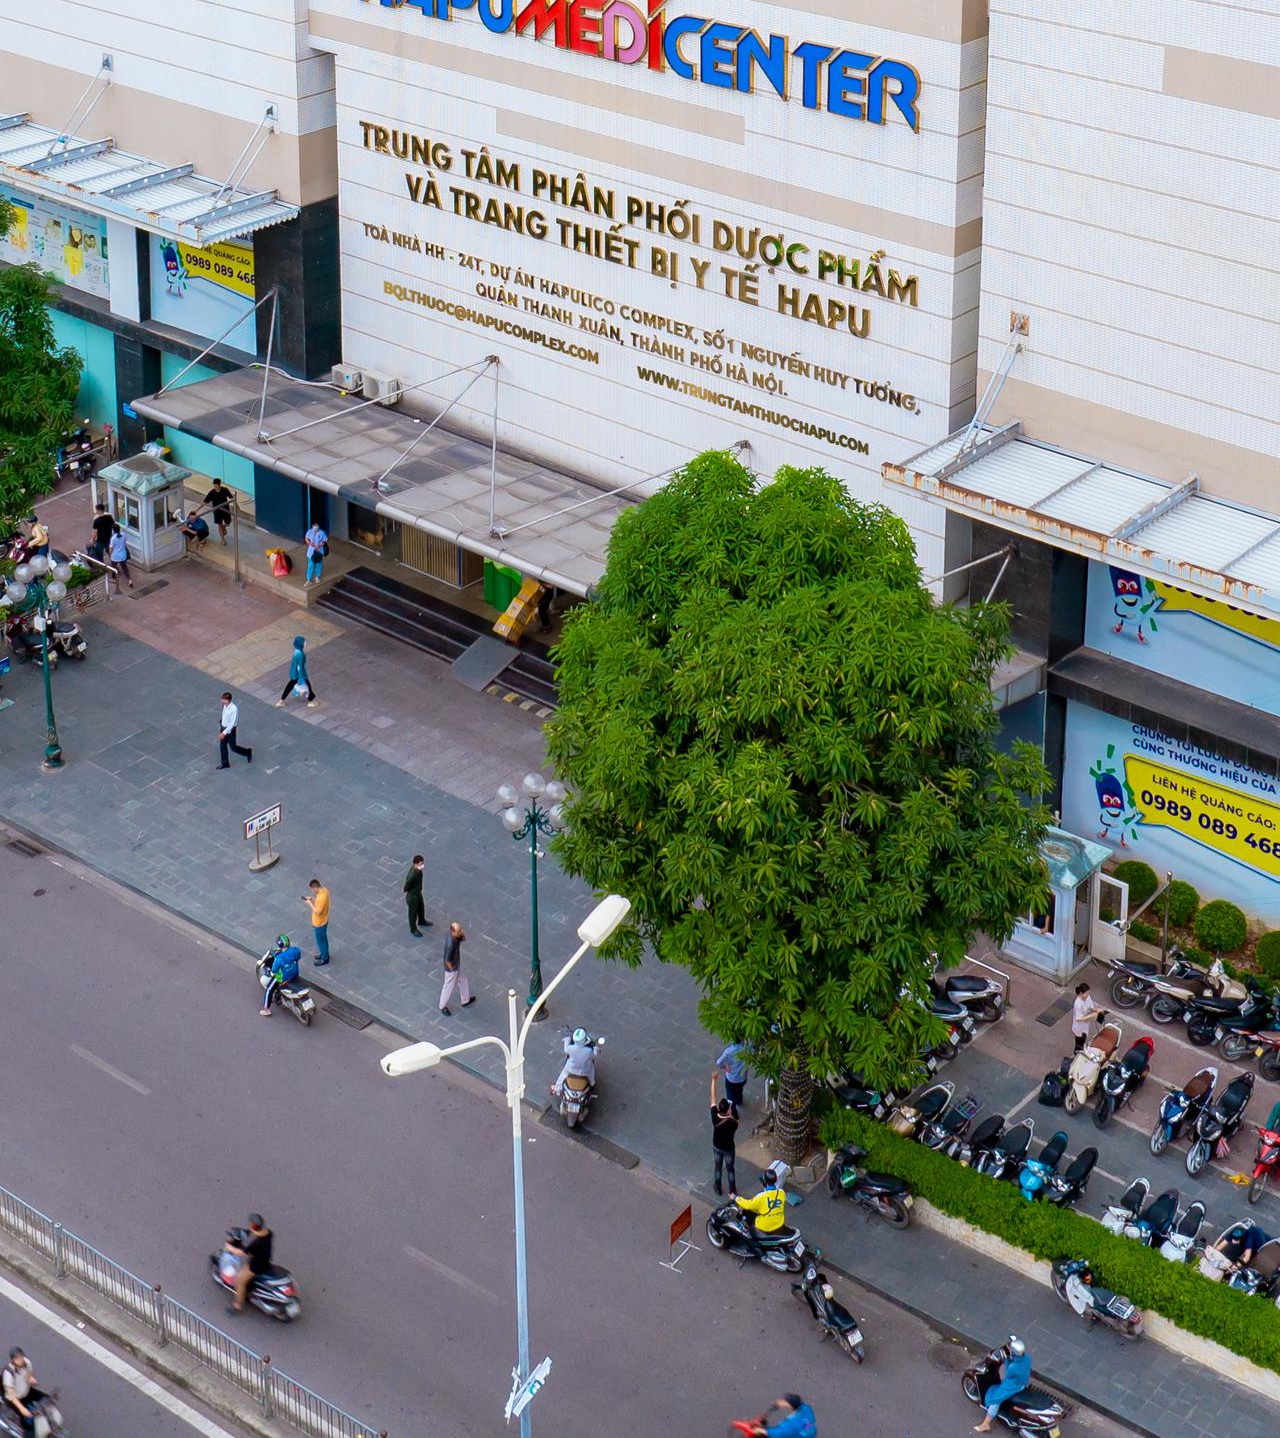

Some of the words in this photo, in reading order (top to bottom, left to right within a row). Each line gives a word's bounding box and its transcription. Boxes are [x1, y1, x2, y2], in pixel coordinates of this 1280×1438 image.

[359, 120, 453, 171] TRUNG
[461, 146, 520, 192] TÂM
[532, 172, 616, 219] PHÂN
[627, 196, 701, 244] PHỐI
[713, 220, 810, 275] DƯỢC
[818, 249, 919, 307] PHẨM
[405, 171, 444, 210] VÀ
[450, 185, 549, 240] TRANG
[556, 217, 641, 268] THIẾT
[651, 246, 679, 289] BỊ
[690, 256, 711, 290] Y
[720, 263, 760, 307] TẾ
[778, 283, 871, 340] HAPU
[186, 253, 211, 270] 0989
[214, 263, 233, 278] 089
[384, 281, 599, 364] BQLTHUOC@HAPUCOMPLEX.COM
[392, 233, 422, 253] NHÀ
[425, 242, 445, 260] HH
[458, 252, 486, 276] 24T,
[514, 265, 535, 290] ÁN
[540, 277, 616, 316] HAPULICO
[620, 305, 698, 344] COMPLEX,
[741, 343, 811, 378] NGUYỄN
[814, 366, 848, 390] HUY
[476, 282, 518, 308] QUẬN
[522, 296, 573, 326] THANH
[579, 314, 625, 345] XUÂN,
[630, 332, 685, 362] THÀNH
[691, 350, 723, 375] PHỐ
[726, 362, 749, 384] HÀ
[752, 370, 788, 396] NỘI.
[637, 366, 870, 455] WWW.TRUNGTAMTHUOCHAPU.COM
[1133, 738, 1165, 756] CÙNG
[1167, 749, 1217, 774] THƯƠNG
[1220, 768, 1248, 785] HIỆU
[1251, 778, 1277, 795] CỦA
[1152, 773, 1178, 792] LIÊN
[1181, 785, 1197, 801] HỆ
[1200, 793, 1244, 817] QUẢNG
[1247, 811, 1277, 831] CÁO:
[1140, 790, 1192, 821] 0989
[1198, 813, 1238, 840] 089
